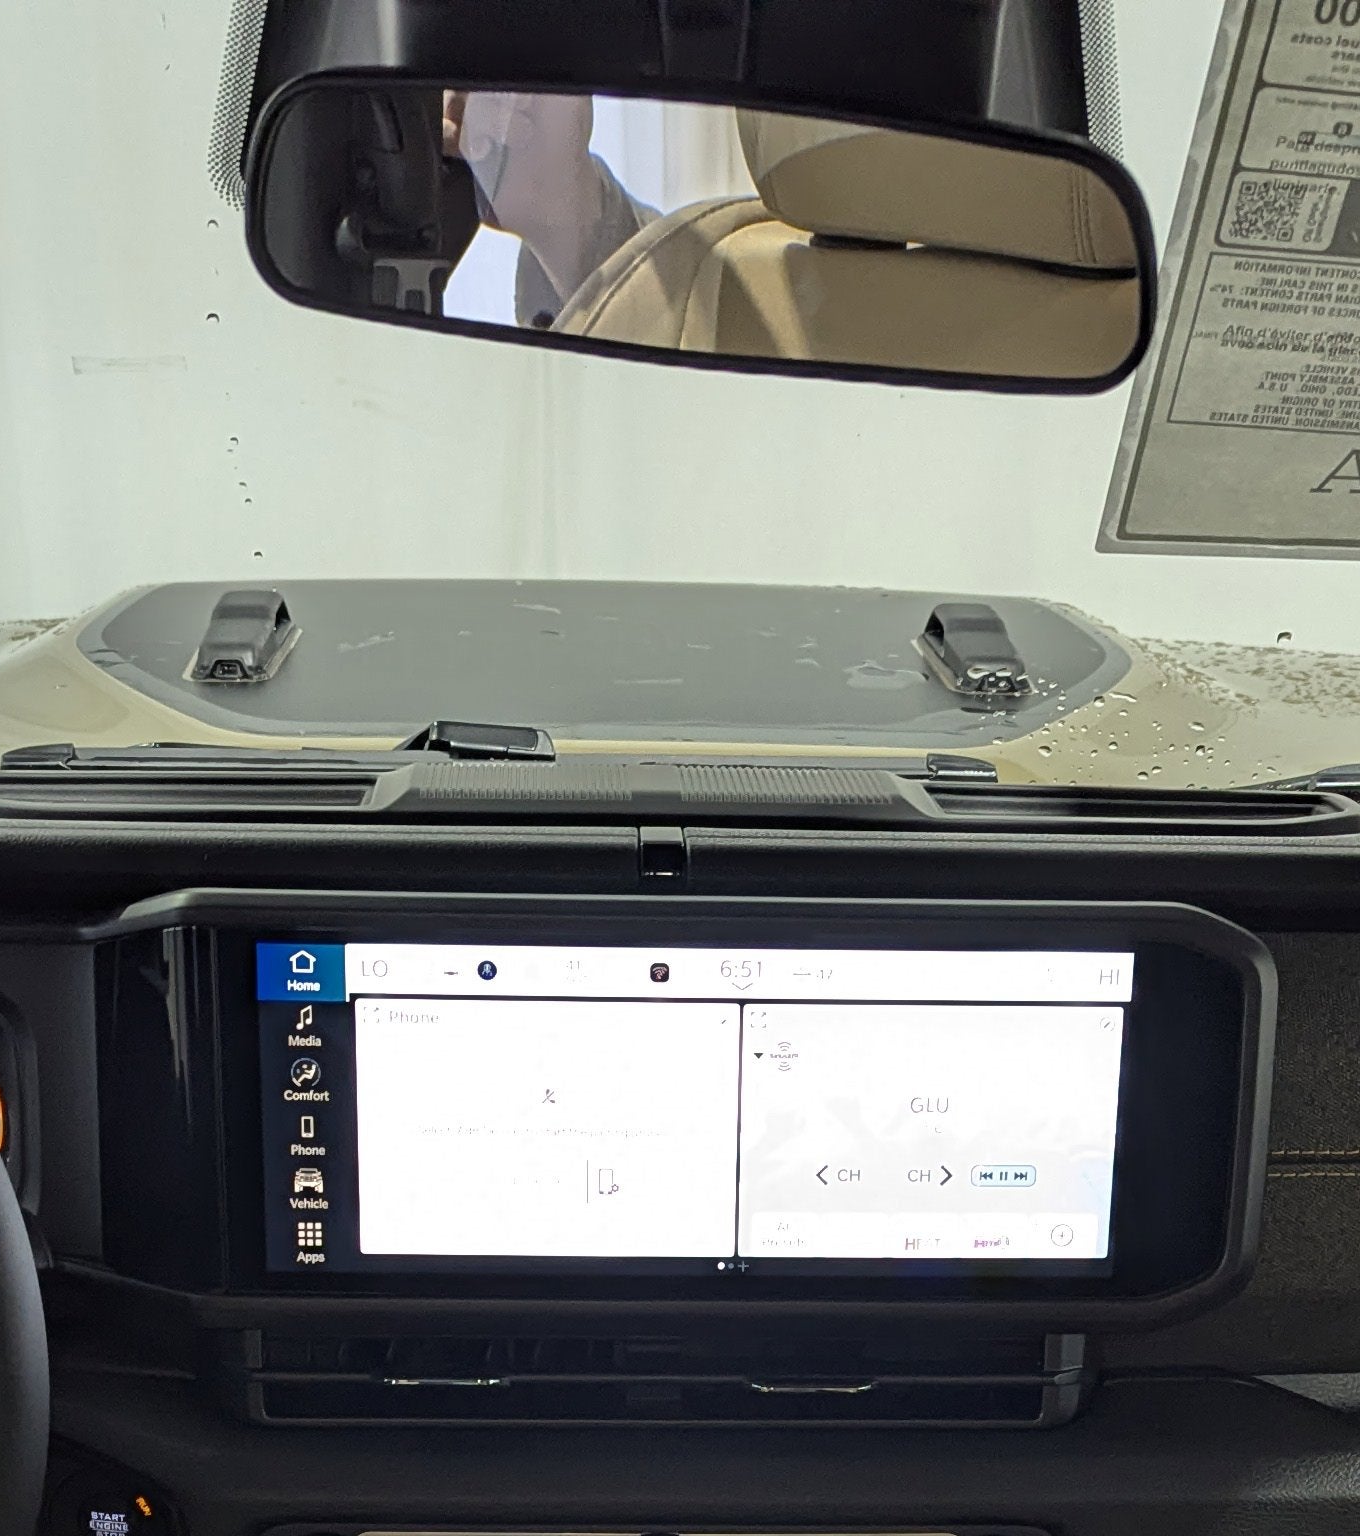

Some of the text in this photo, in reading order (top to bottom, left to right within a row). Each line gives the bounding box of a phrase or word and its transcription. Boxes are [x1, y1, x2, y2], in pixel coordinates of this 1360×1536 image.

[361, 959, 388, 978] LO
[719, 960, 763, 979] 6:51
[1098, 967, 1122, 986] HI
[286, 980, 321, 992] Home
[288, 1035, 322, 1047] Media
[283, 1090, 330, 1102] Comfort
[290, 1144, 325, 1156] Phone
[837, 1169, 861, 1183] CH
[907, 1169, 931, 1183] CH
[289, 1198, 328, 1210] Vehicle
[296, 1252, 325, 1264] Apps
[136, 1497, 152, 1517] RUN
[90, 1511, 125, 1522] START
[89, 1521, 129, 1532] ENGINE
